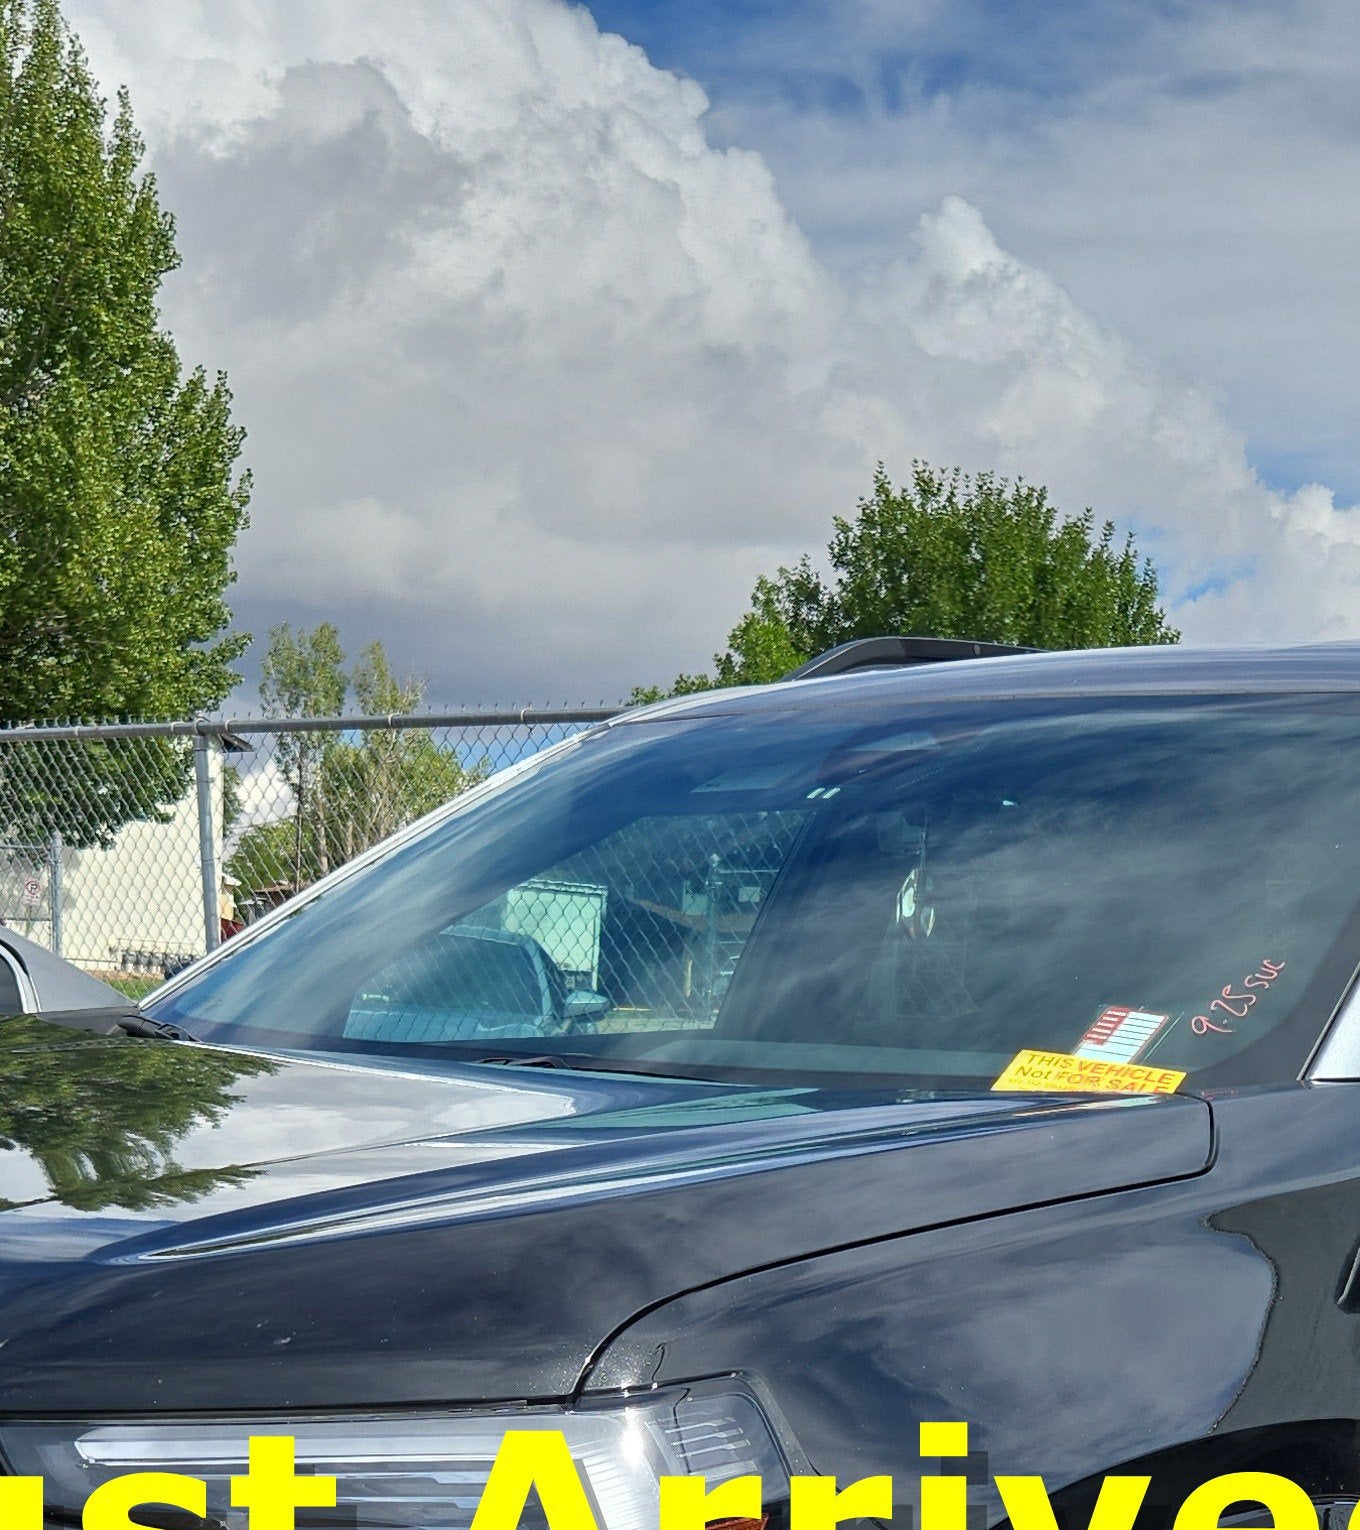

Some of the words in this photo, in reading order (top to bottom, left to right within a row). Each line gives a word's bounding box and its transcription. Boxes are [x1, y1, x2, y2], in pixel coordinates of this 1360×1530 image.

[1015, 1065, 1051, 1080] Not
[1055, 1071, 1100, 1088] FOR
[1026, 1053, 1075, 1069] THIS
[1077, 1060, 1176, 1085] VEHICLE
